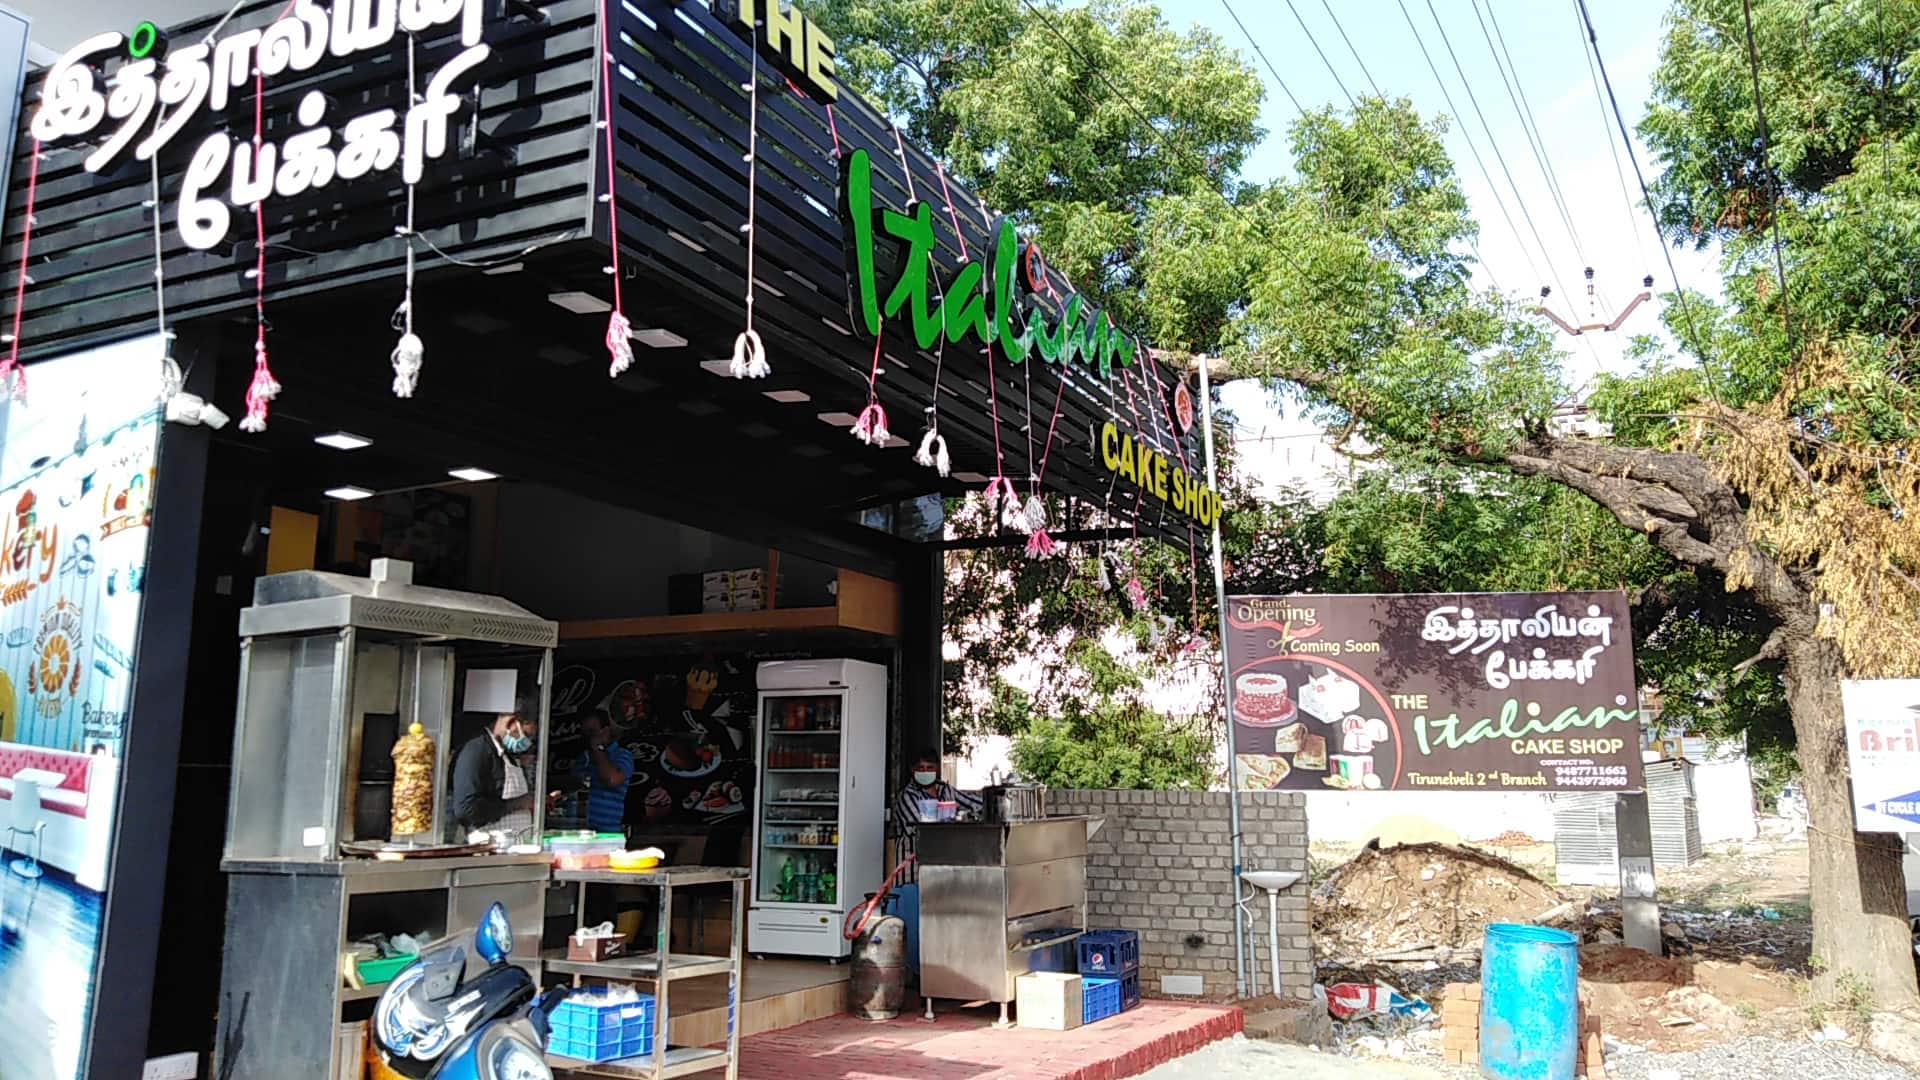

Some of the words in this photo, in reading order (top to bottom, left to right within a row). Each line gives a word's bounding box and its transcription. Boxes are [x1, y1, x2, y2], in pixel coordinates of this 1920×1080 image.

[177, 43, 490, 248] பேக்கரி
[849, 149, 1135, 379] Italian
[1102, 422, 1168, 502] CAKE
[1172, 467, 1224, 529] SHOP
[1250, 598, 1288, 609] Grand
[1238, 604, 1316, 626] Opening
[1421, 604, 1613, 655] இத்தாலியன்
[1290, 638, 1341, 656] Coming
[1344, 639, 1380, 653] Soon
[1485, 645, 1604, 689] பேக்கரி
[1391, 694, 1428, 710] THE
[1511, 738, 1565, 755] CAKE
[1569, 737, 1624, 754] SHOP
[1477, 773, 1486, 786] 2
[1501, 771, 1547, 786] Branch
